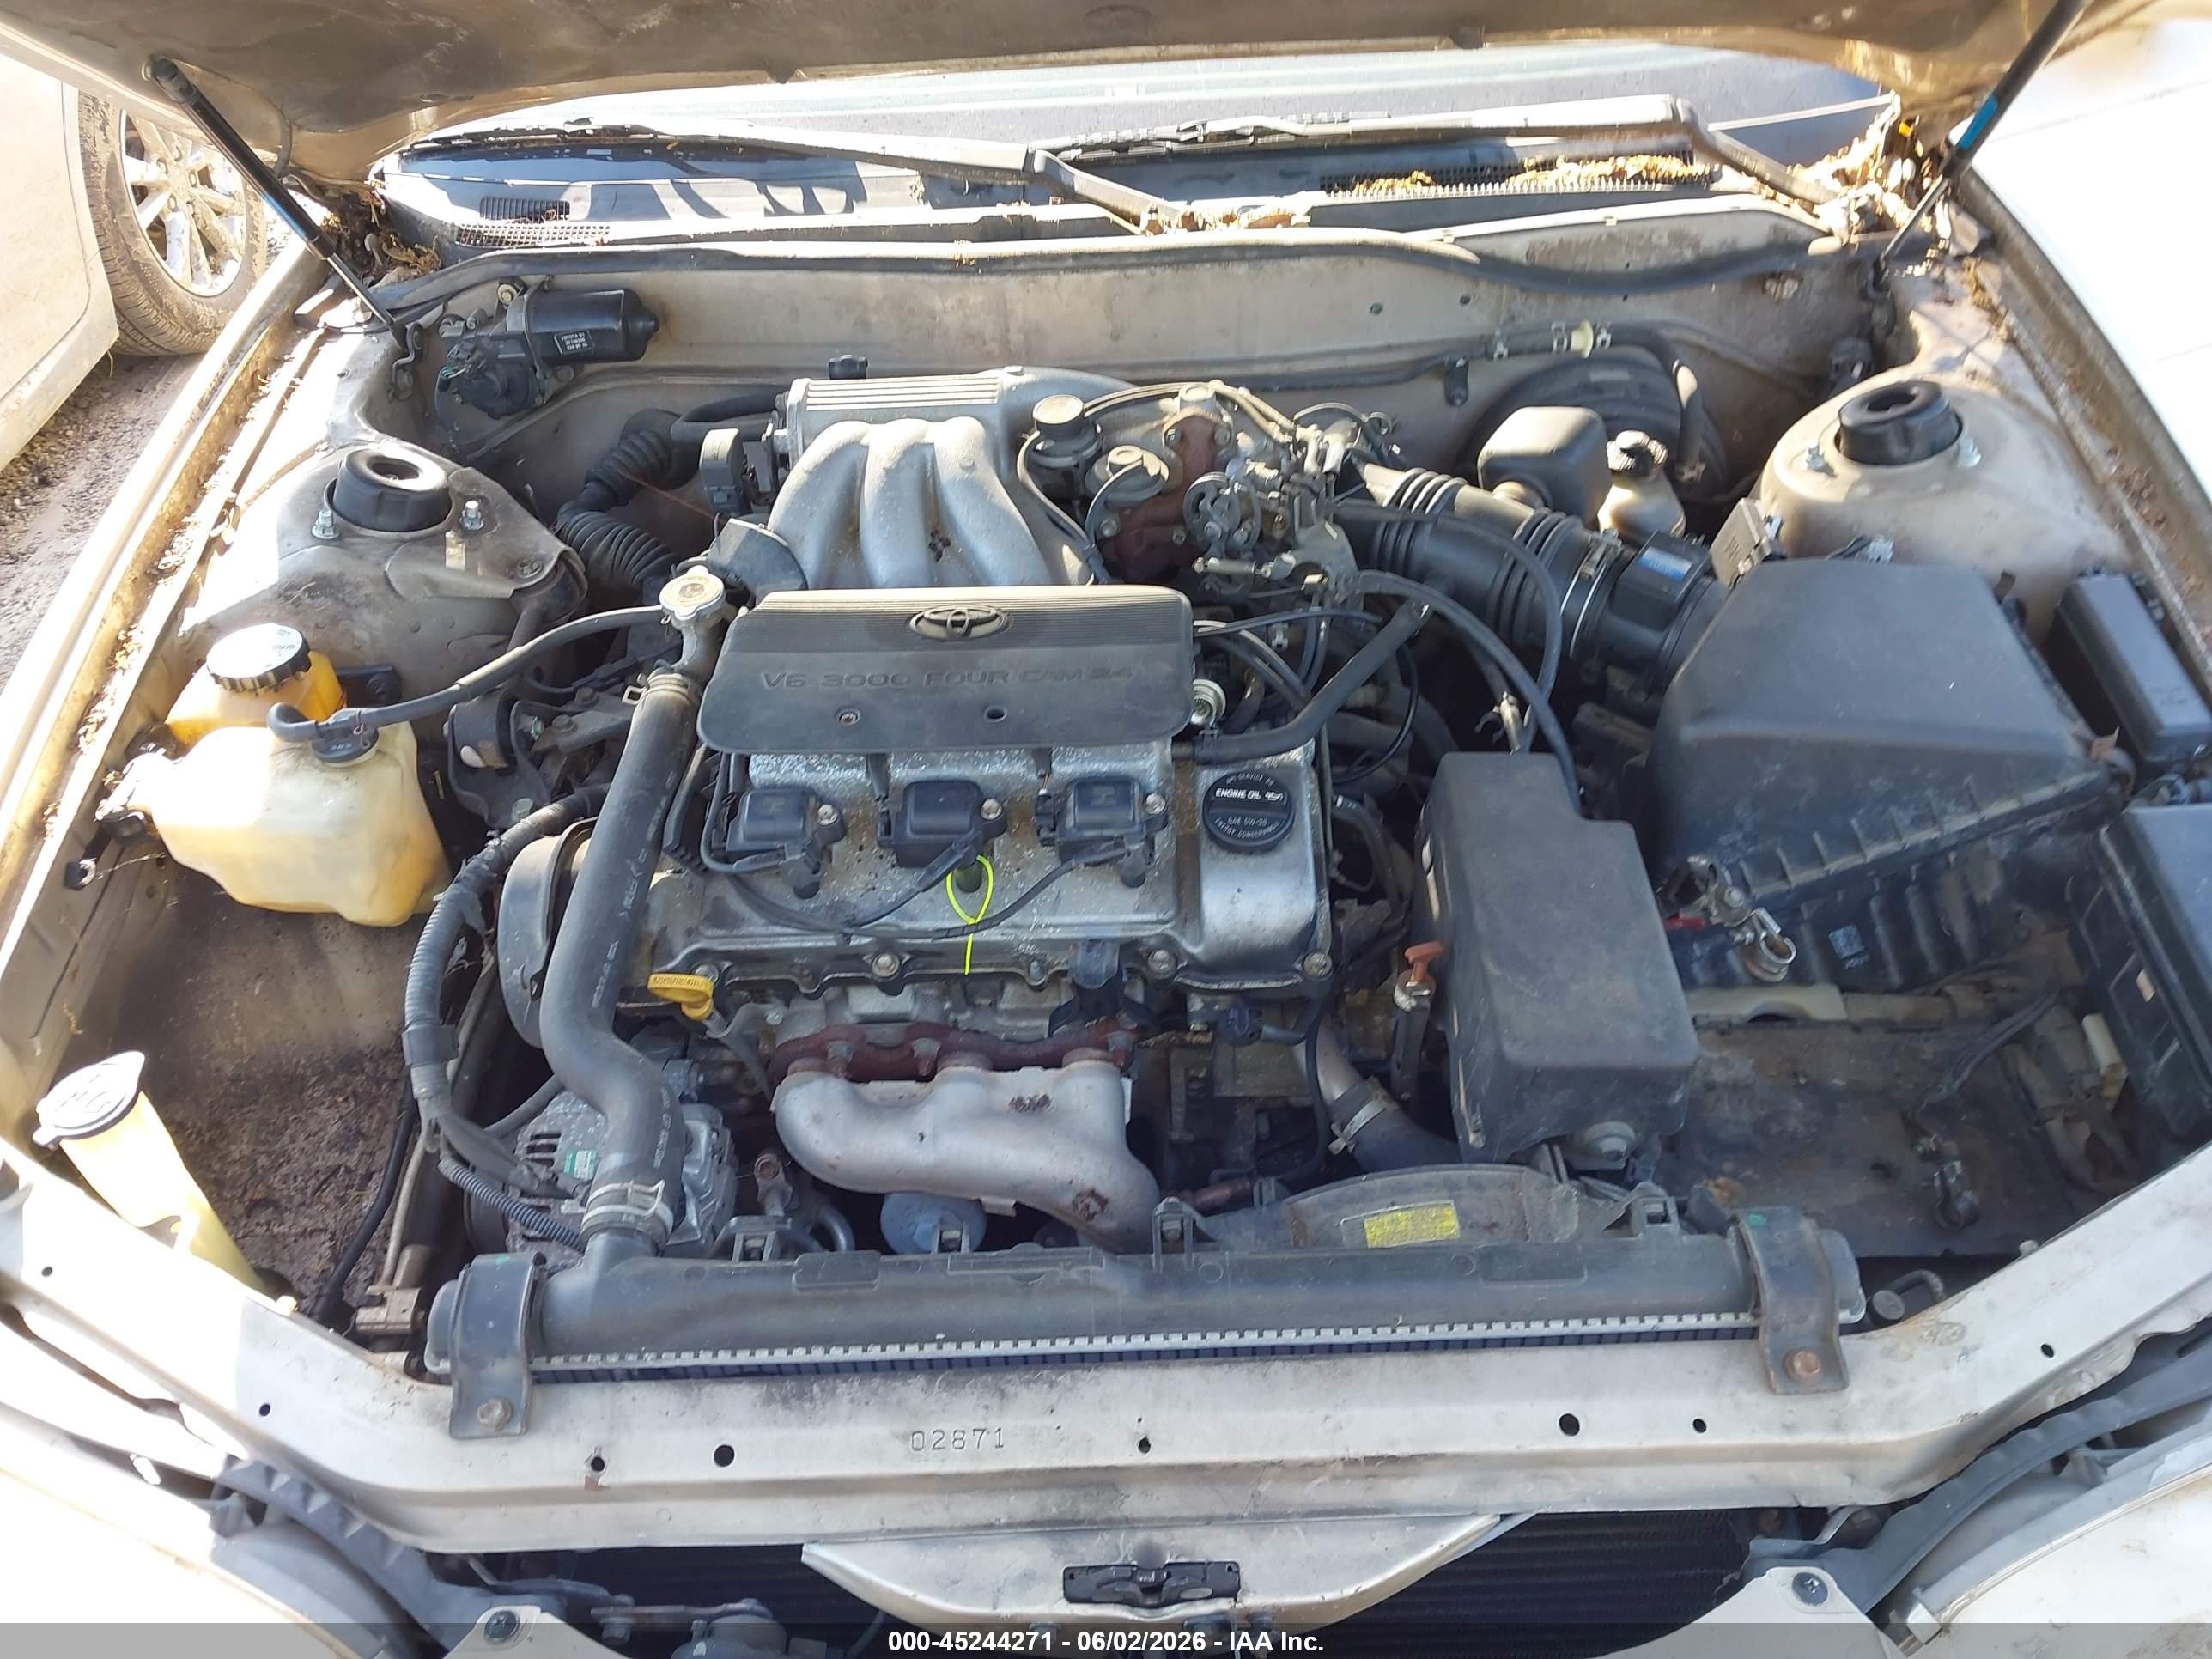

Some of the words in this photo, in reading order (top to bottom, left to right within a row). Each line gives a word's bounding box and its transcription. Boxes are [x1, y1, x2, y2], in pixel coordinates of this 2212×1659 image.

[762, 672, 807, 688] V6
[821, 672, 911, 687] 3000
[924, 670, 1010, 687] FOUR
[1018, 669, 1086, 684] CAM
[1091, 667, 1134, 681] 24
[1215, 788, 1246, 799] ENGINE
[1247, 790, 1262, 800] OIL
[911, 1426, 1004, 1452] 02871
